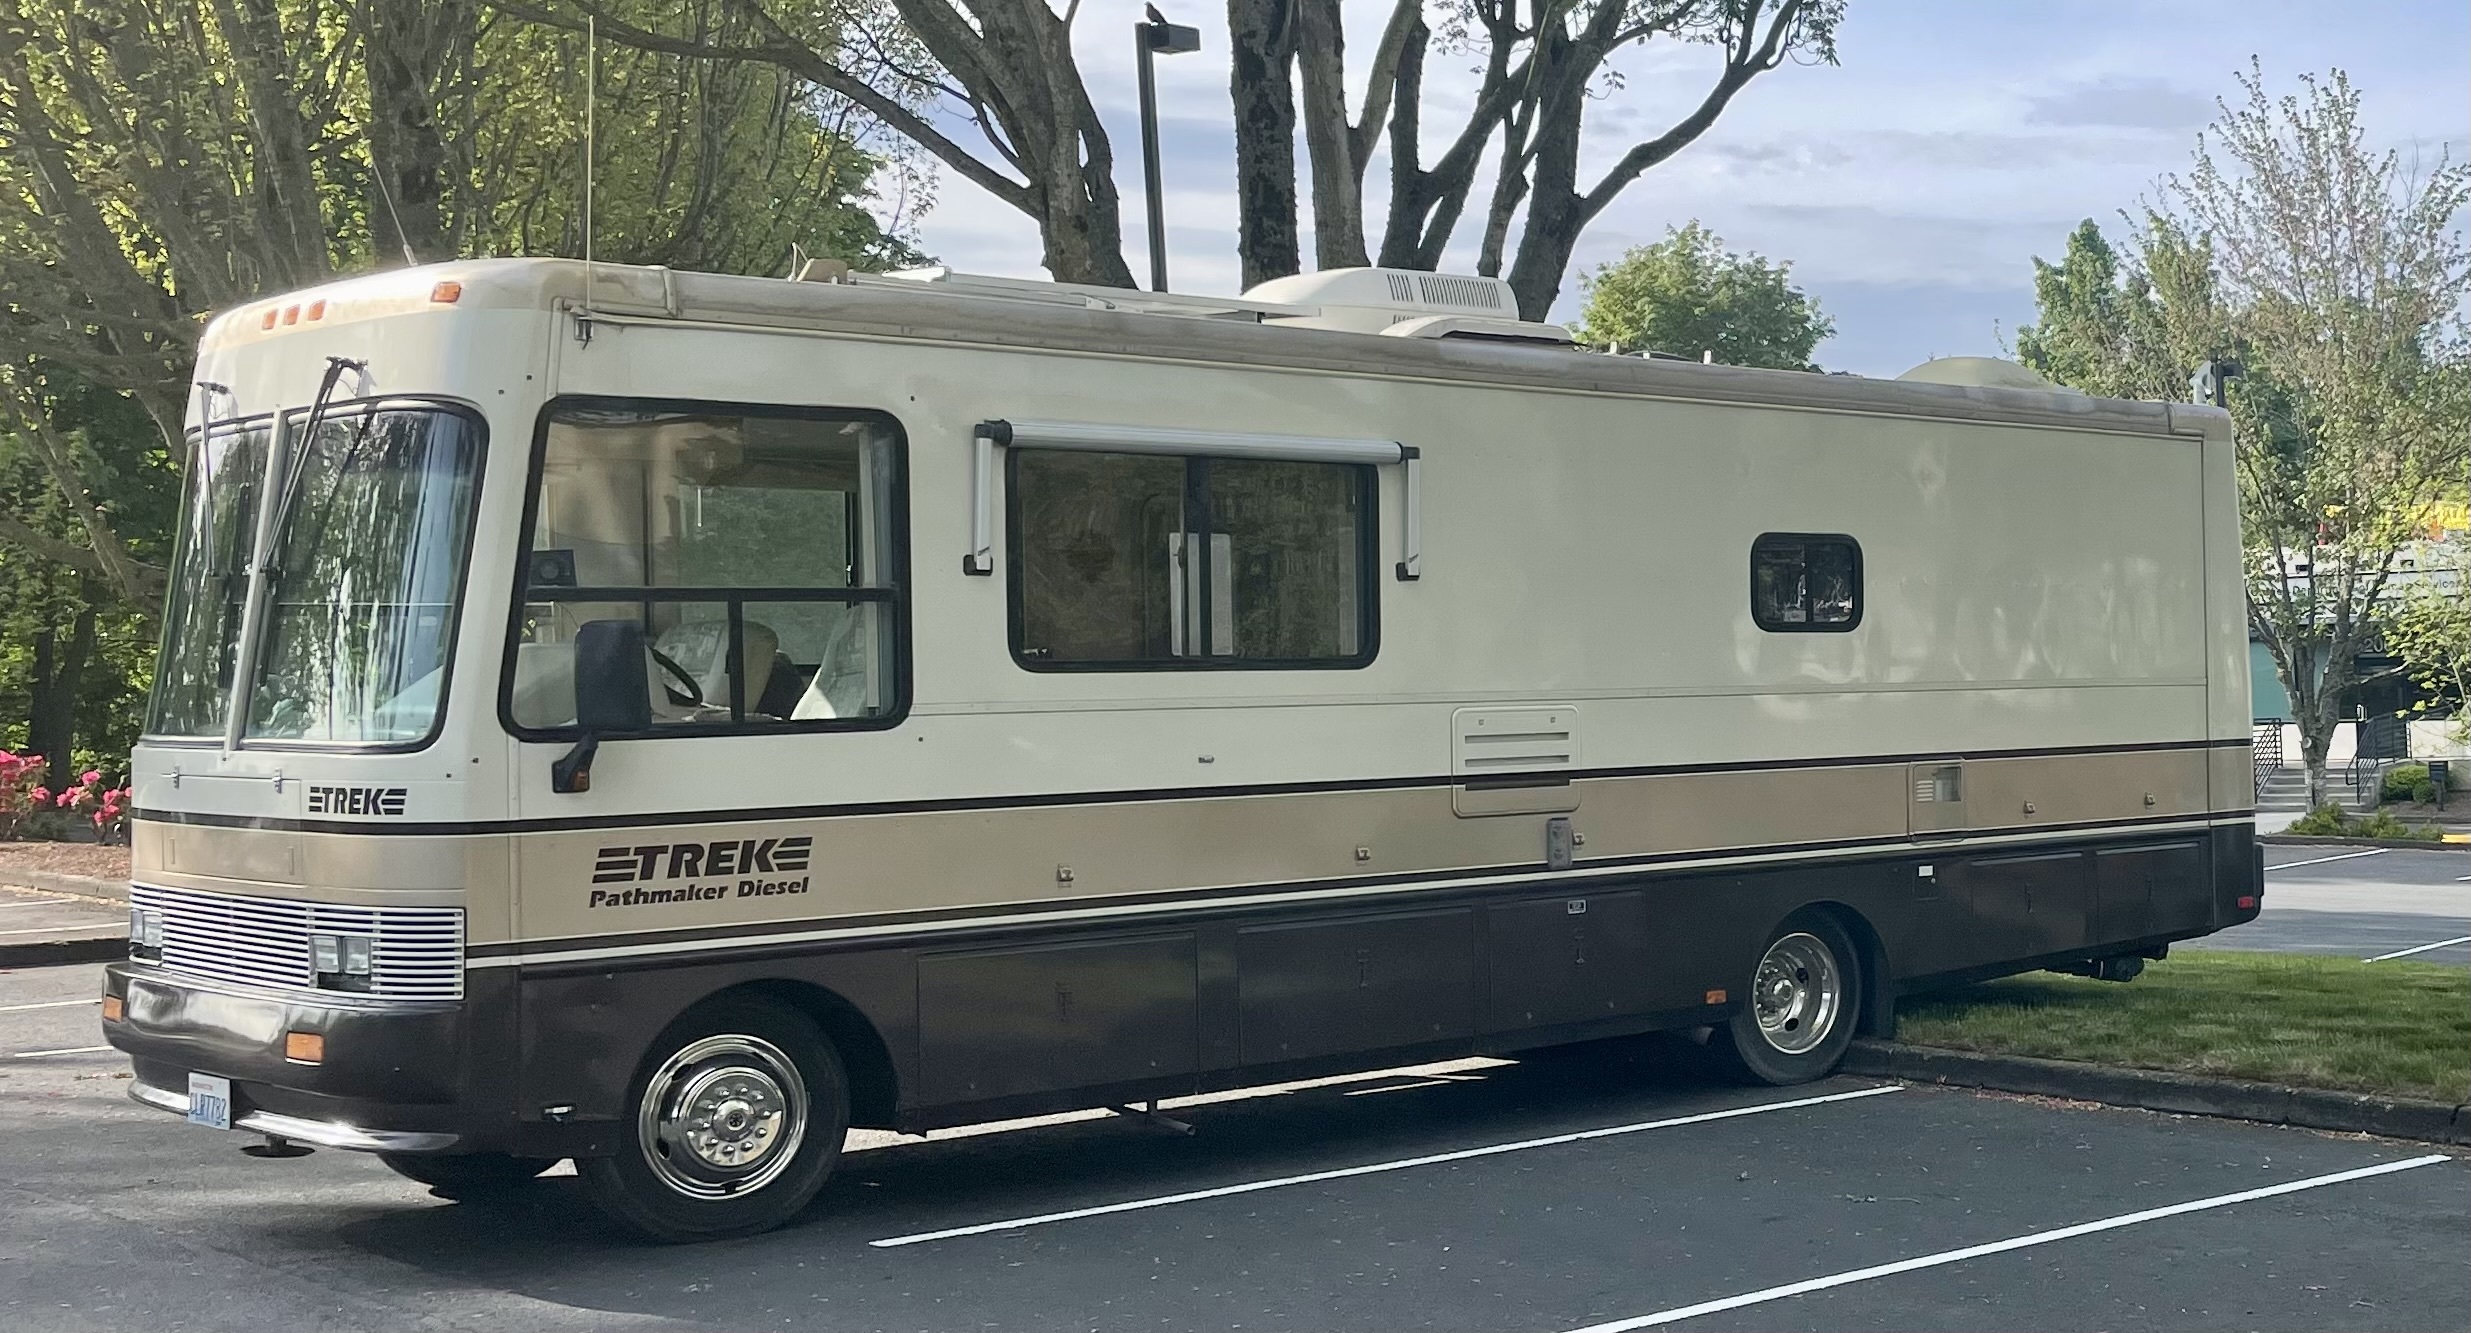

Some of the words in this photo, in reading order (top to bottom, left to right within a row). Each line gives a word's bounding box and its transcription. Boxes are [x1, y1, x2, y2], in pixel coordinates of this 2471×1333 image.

[321, 787, 385, 815] TREK
[633, 838, 780, 881] TREK
[589, 884, 729, 908] Pathmaker
[736, 877, 810, 898] Diesel
